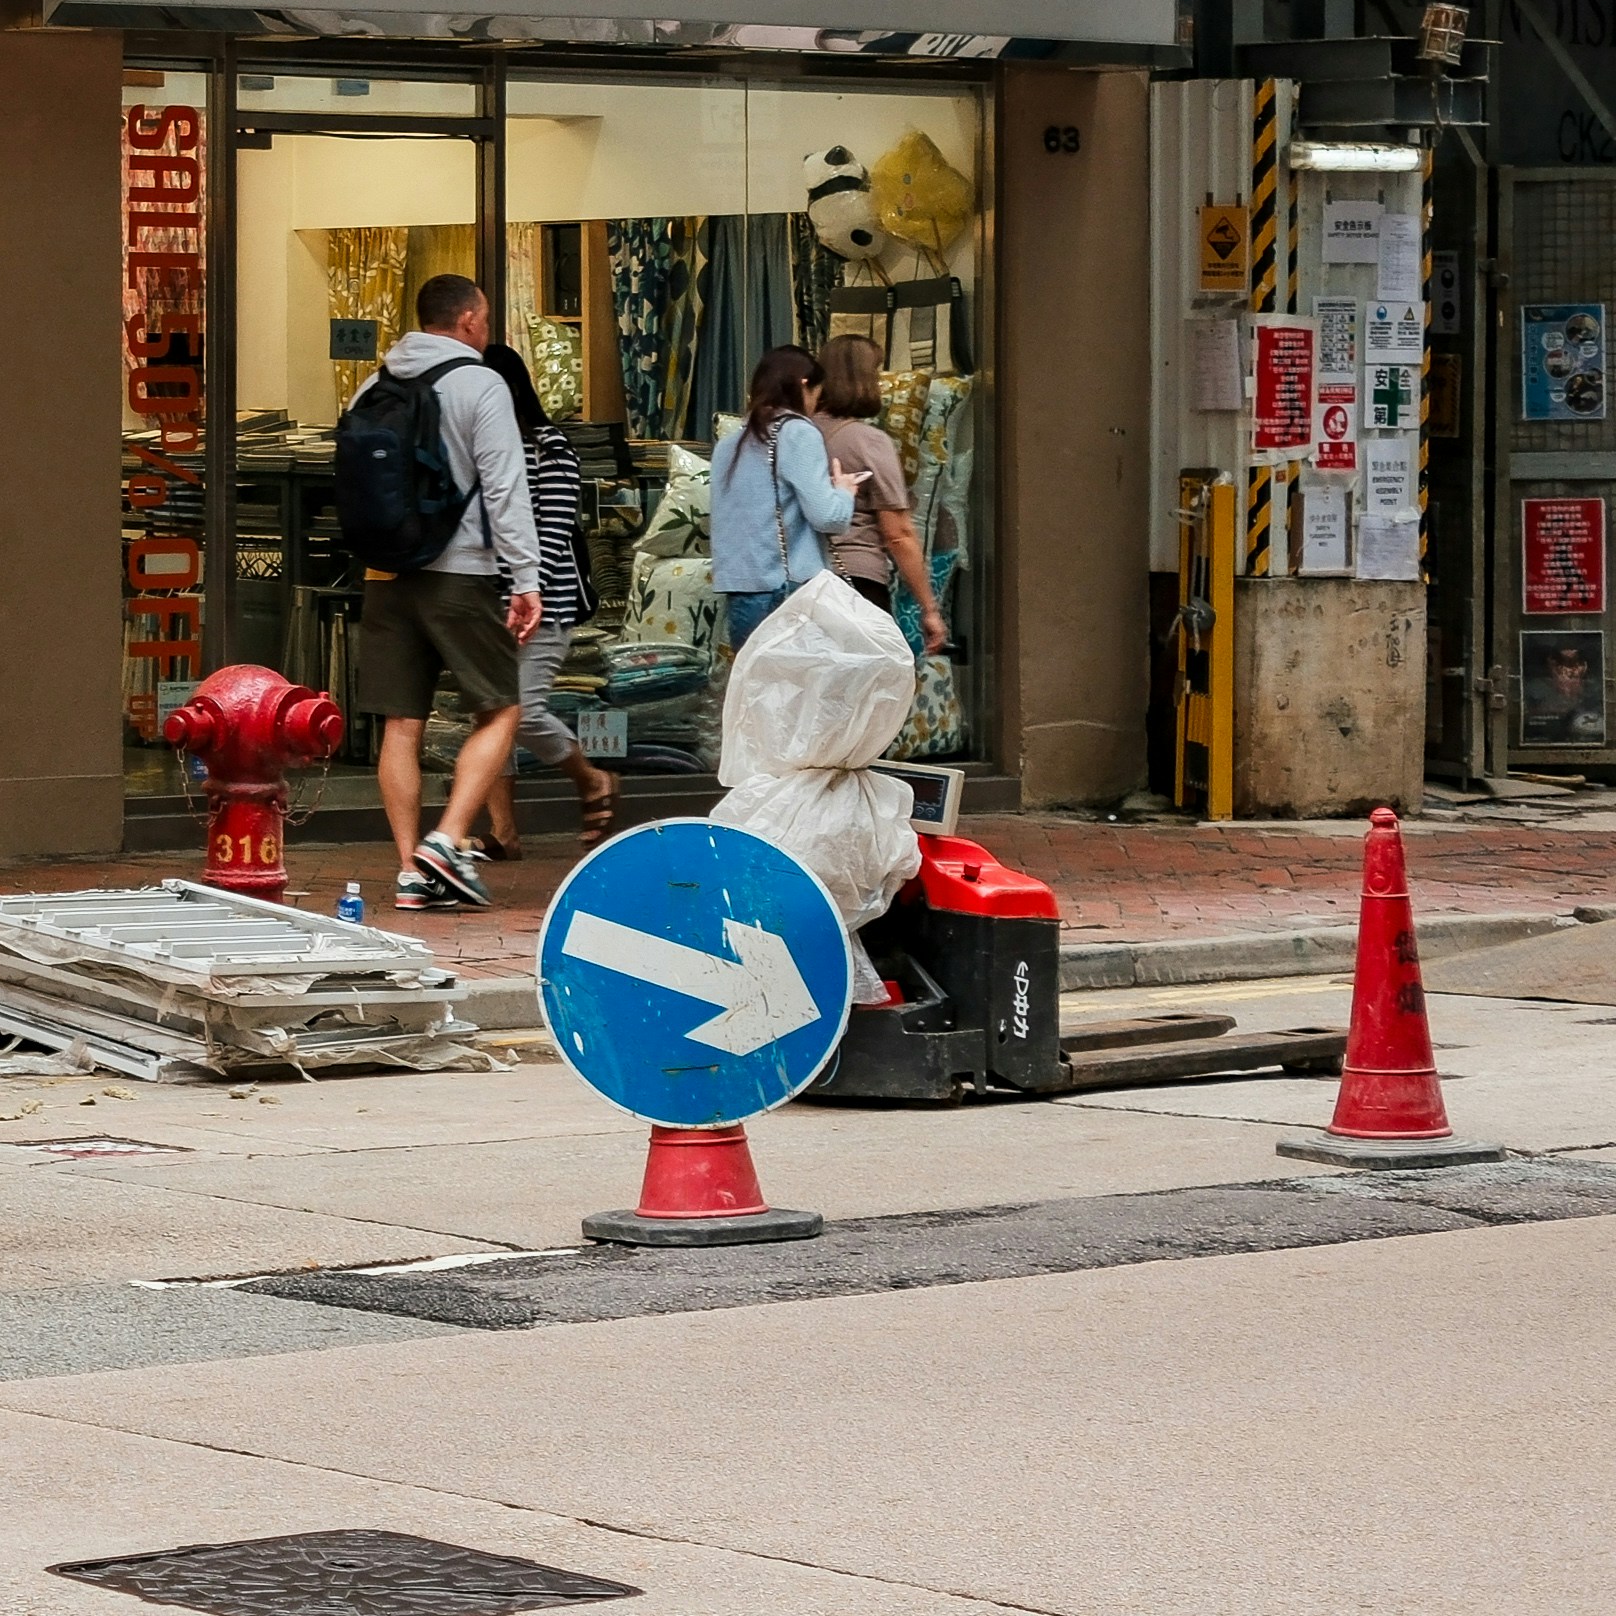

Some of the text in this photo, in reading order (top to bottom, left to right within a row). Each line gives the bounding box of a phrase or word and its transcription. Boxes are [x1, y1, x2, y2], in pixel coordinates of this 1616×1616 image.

[128, 103, 200, 292] SALE
[1043, 124, 1081, 154] 63
[128, 313, 200, 508] 50%
[128, 536, 202, 679] OFF
[216, 834, 278, 865] 316
